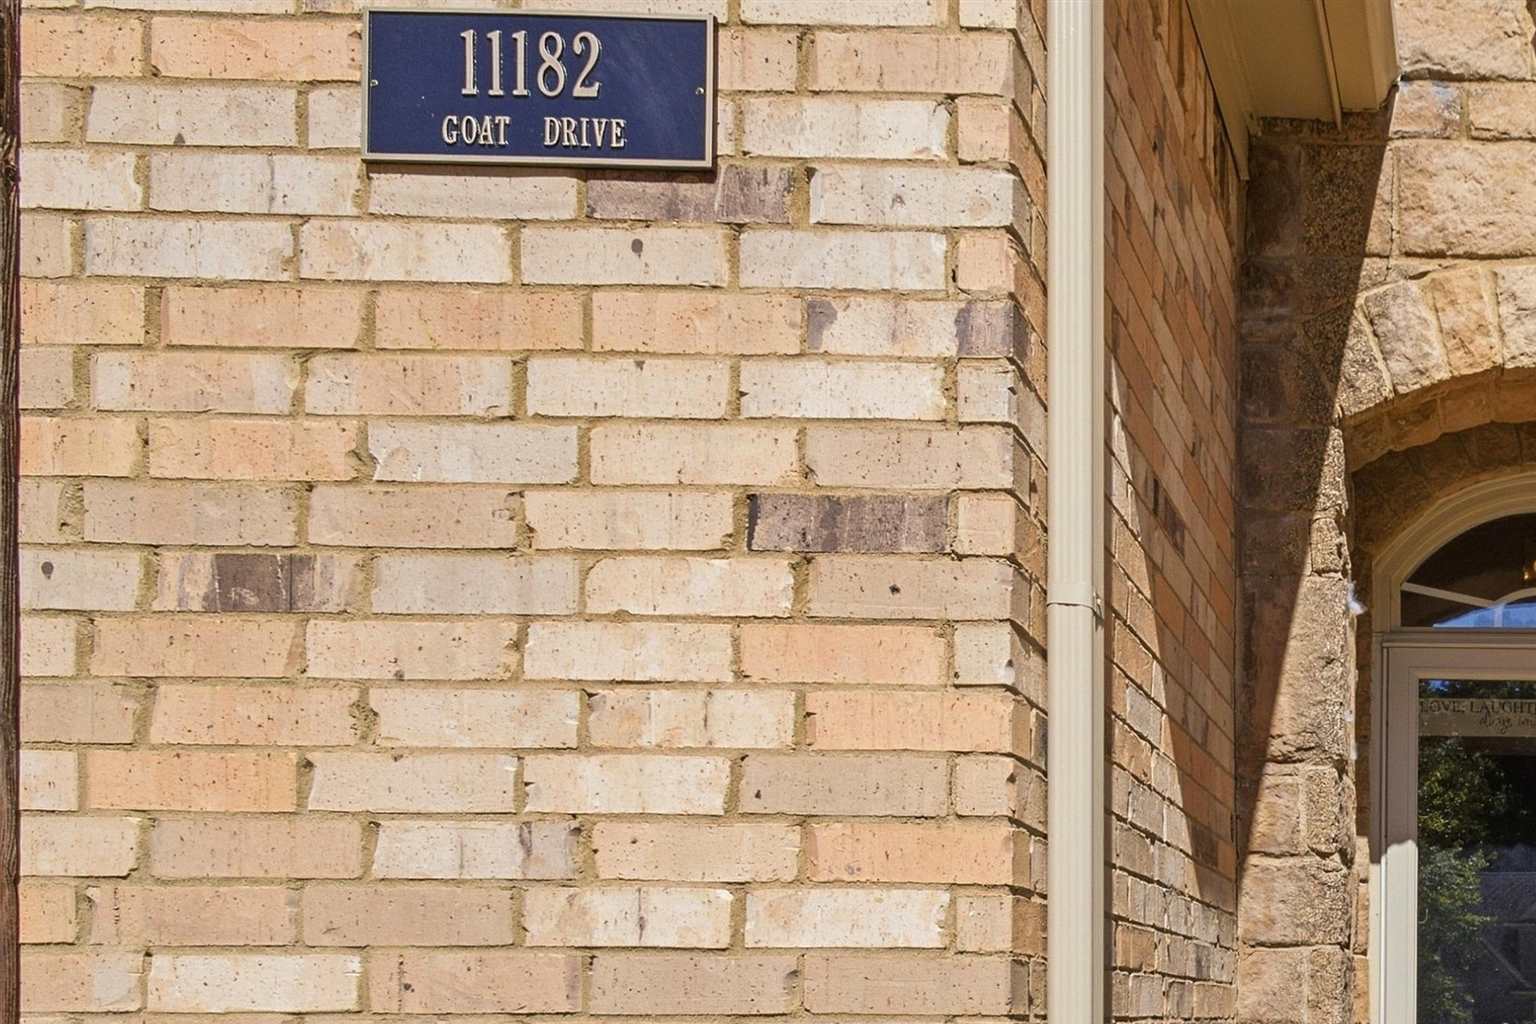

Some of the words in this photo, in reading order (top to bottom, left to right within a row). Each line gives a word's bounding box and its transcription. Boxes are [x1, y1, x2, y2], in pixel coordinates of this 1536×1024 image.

[460, 28, 602, 98] 11182
[441, 115, 511, 146] GOAT
[543, 116, 627, 148] DRIVE
